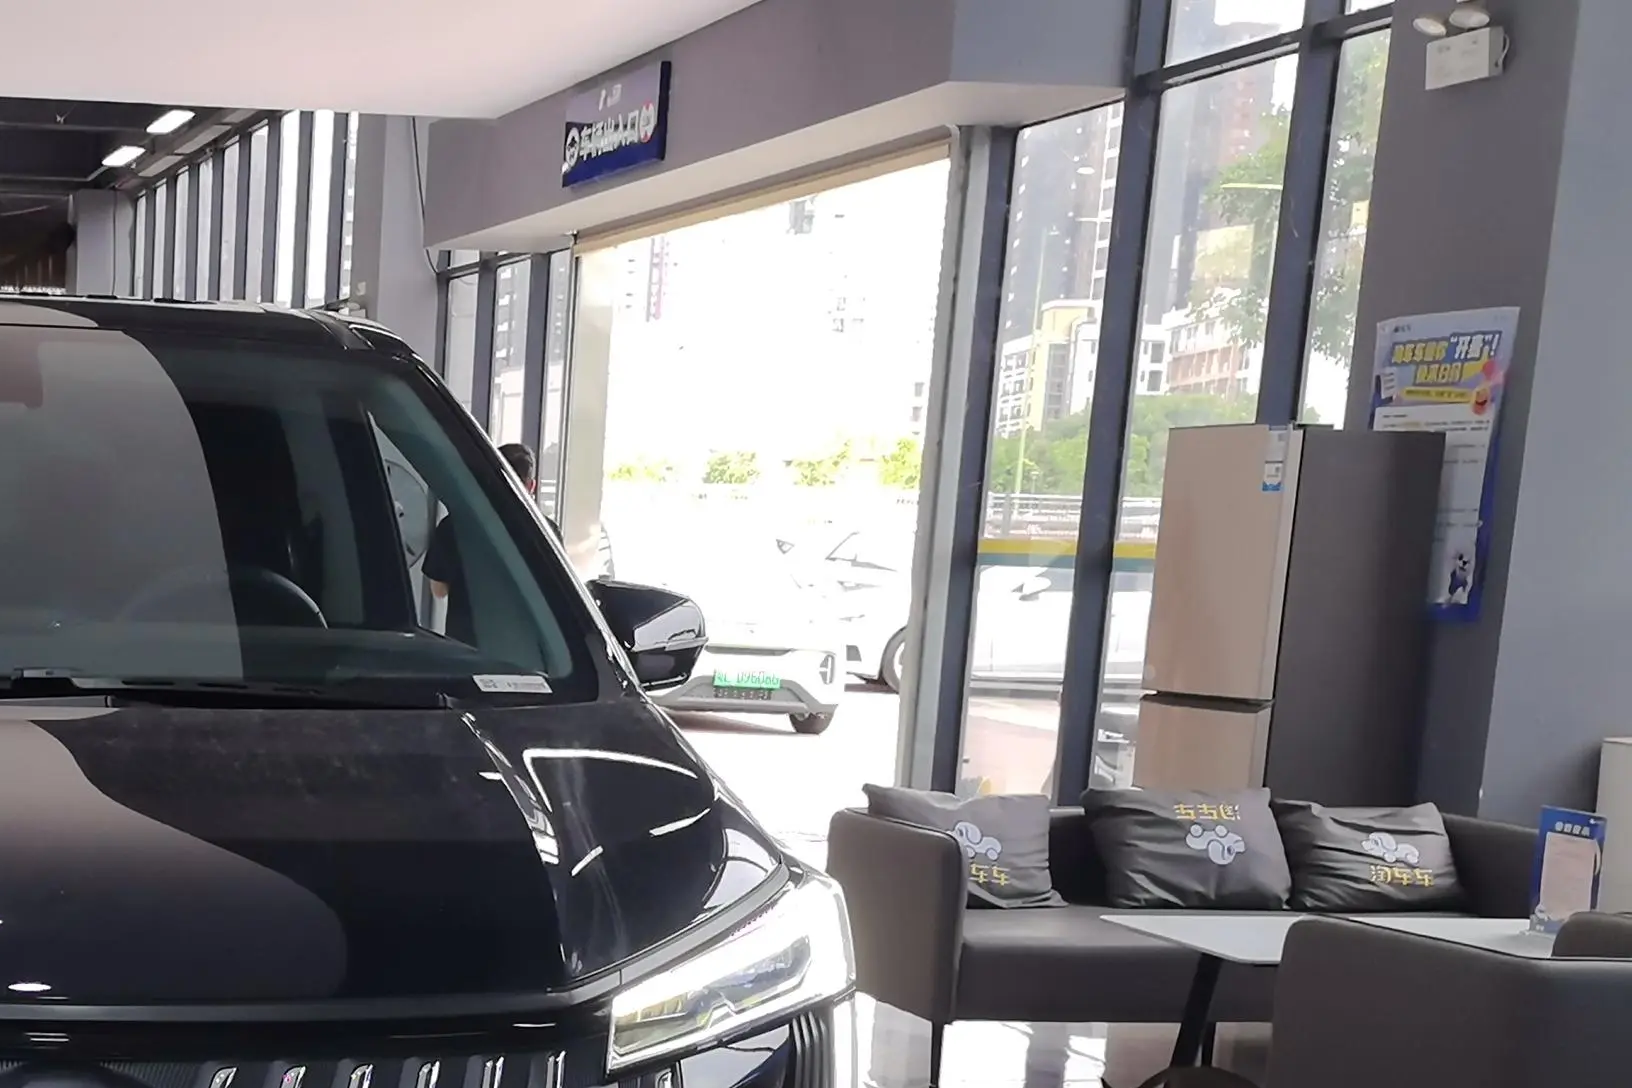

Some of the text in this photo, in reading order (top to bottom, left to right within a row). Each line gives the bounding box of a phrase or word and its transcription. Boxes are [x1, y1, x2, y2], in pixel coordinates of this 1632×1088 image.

[969, 862, 1011, 886] 车车
[1369, 864, 1434, 887] 淘车车
